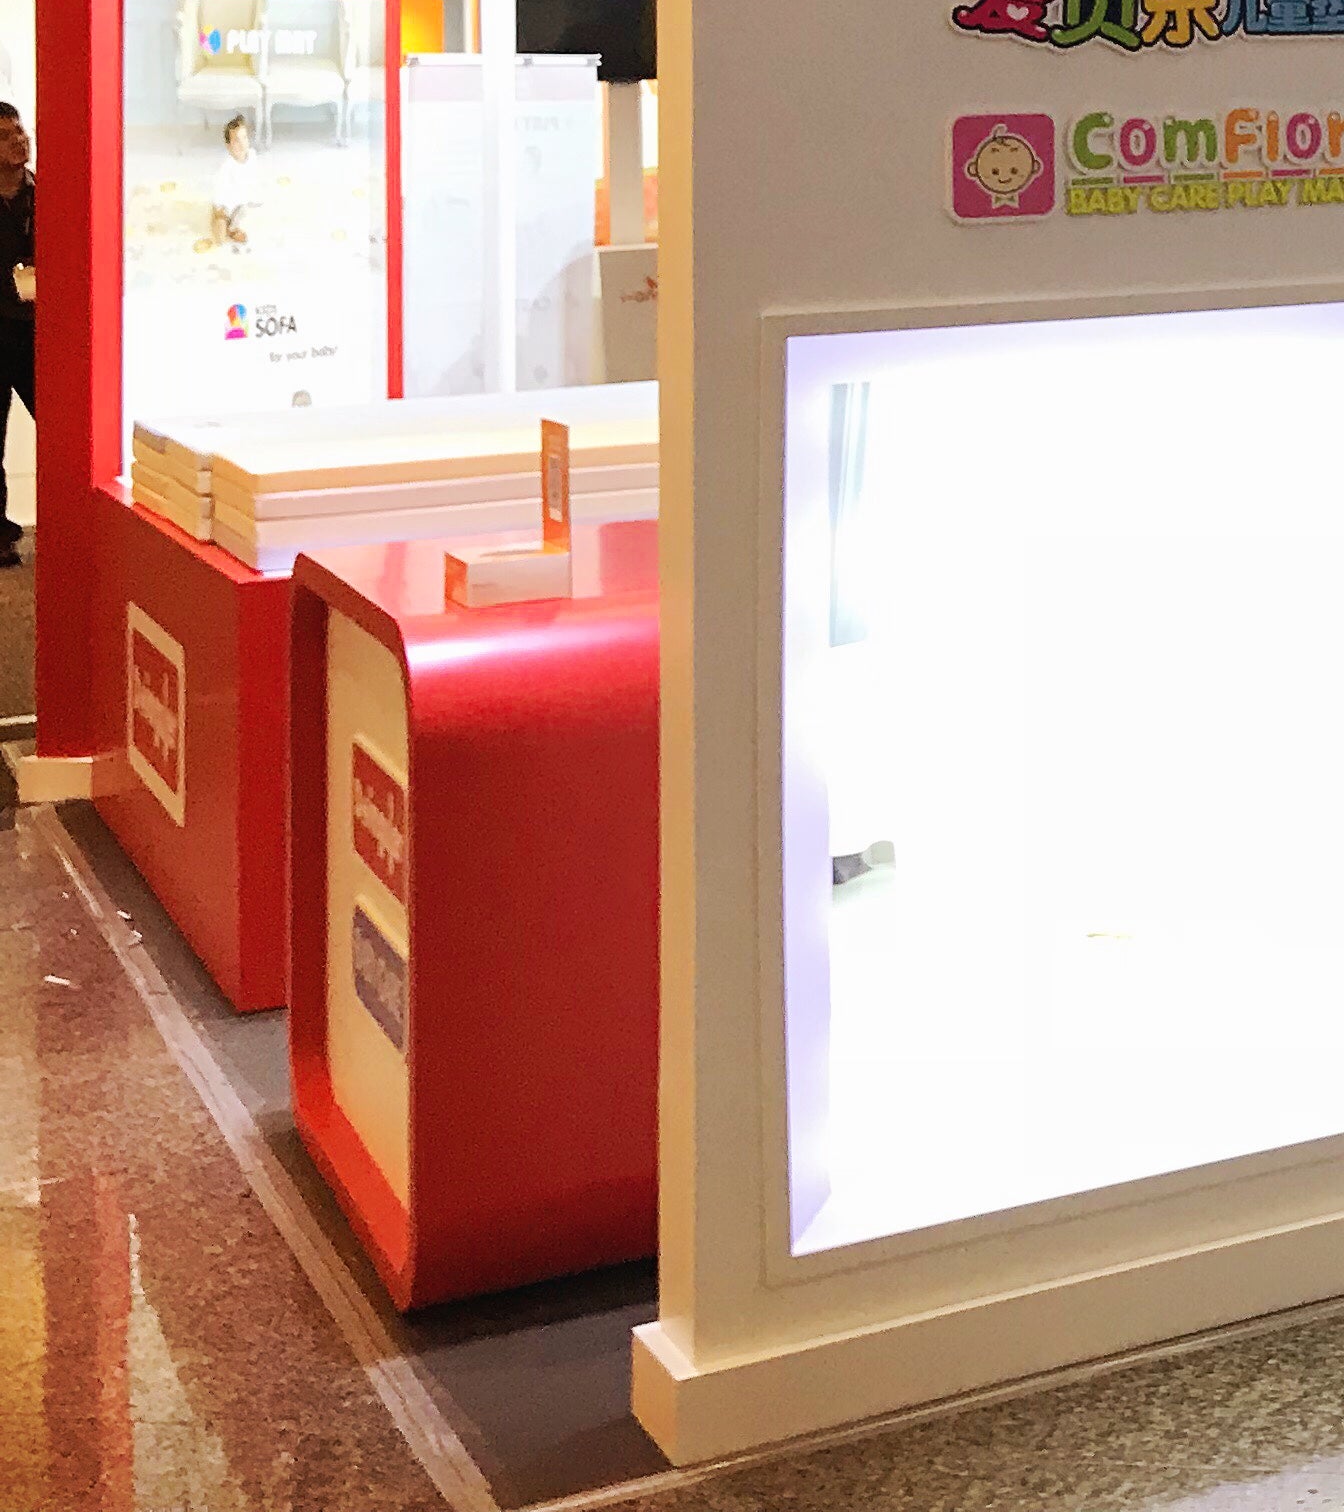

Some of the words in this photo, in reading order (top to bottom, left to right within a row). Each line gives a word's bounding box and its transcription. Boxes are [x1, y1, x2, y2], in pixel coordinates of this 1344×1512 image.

[1066, 186, 1141, 216] BABY
[1148, 183, 1220, 213] CARE
[1225, 178, 1294, 209] PLAY
[255, 316, 297, 338] SOFA
